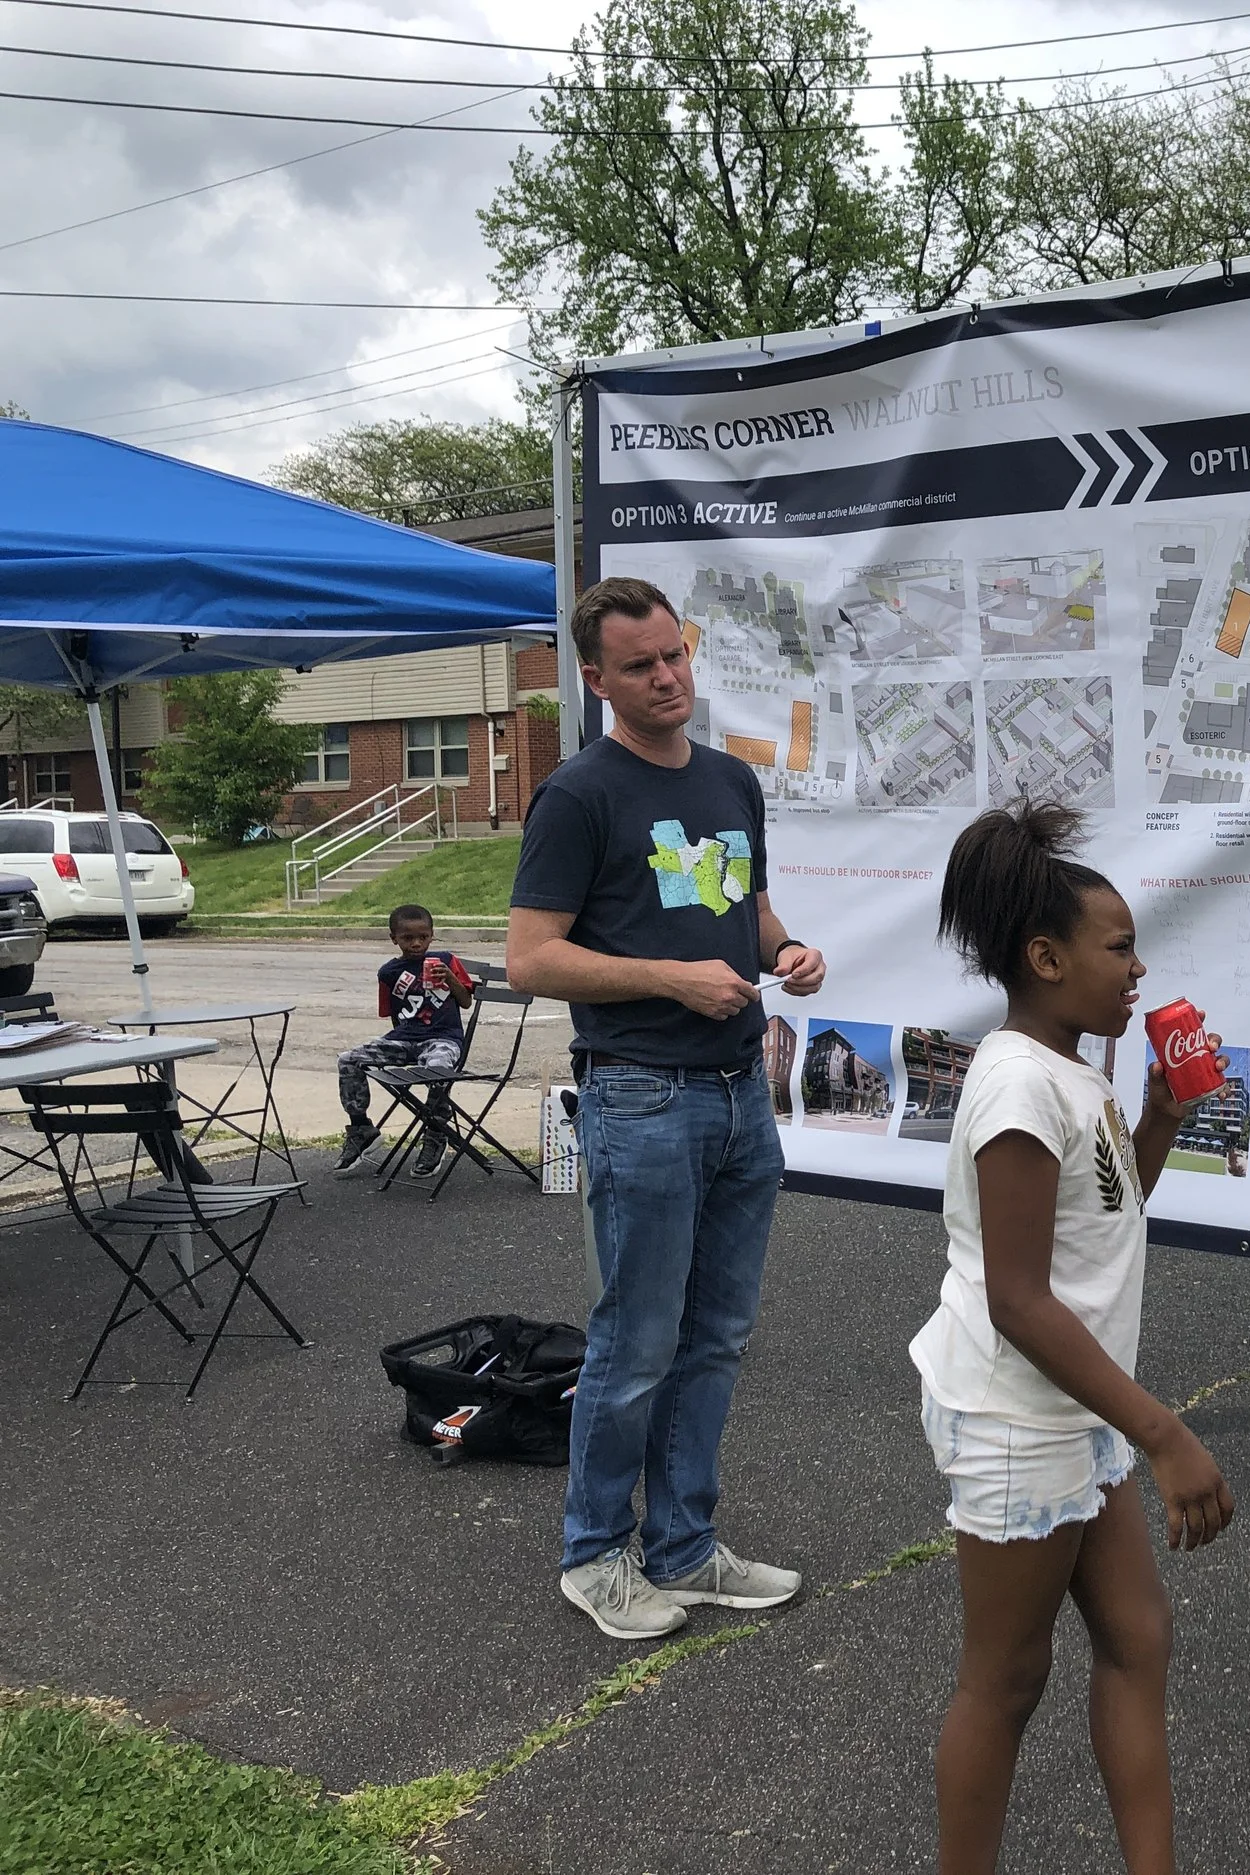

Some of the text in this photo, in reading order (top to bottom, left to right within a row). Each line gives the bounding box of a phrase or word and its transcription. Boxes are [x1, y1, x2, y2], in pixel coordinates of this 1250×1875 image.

[610, 366, 1064, 453] PEEBLES CORNER WALNUT HILLS
[611, 491, 957, 528] OPTION 3 ACTIVE Continue an active McMillan commercial district
[1188, 653, 1194, 663] 6
[1181, 678, 1187, 689] 5
[696, 724, 707, 732] CVS
[1190, 730, 1226, 741] ESOTERIC
[1155, 753, 1162, 764] 5
[813, 783, 818, 792] 5
[1146, 812, 1179, 821] CONCEPT
[1146, 823, 1180, 831] FEATURES
[778, 864, 933, 880] WHAT SHOULD BE IN OUTDOOR SPACE?
[1140, 877, 1167, 888] WHAT
[1168, 877, 1208, 888] RETAIL
[1165, 1028, 1209, 1069] Coca
